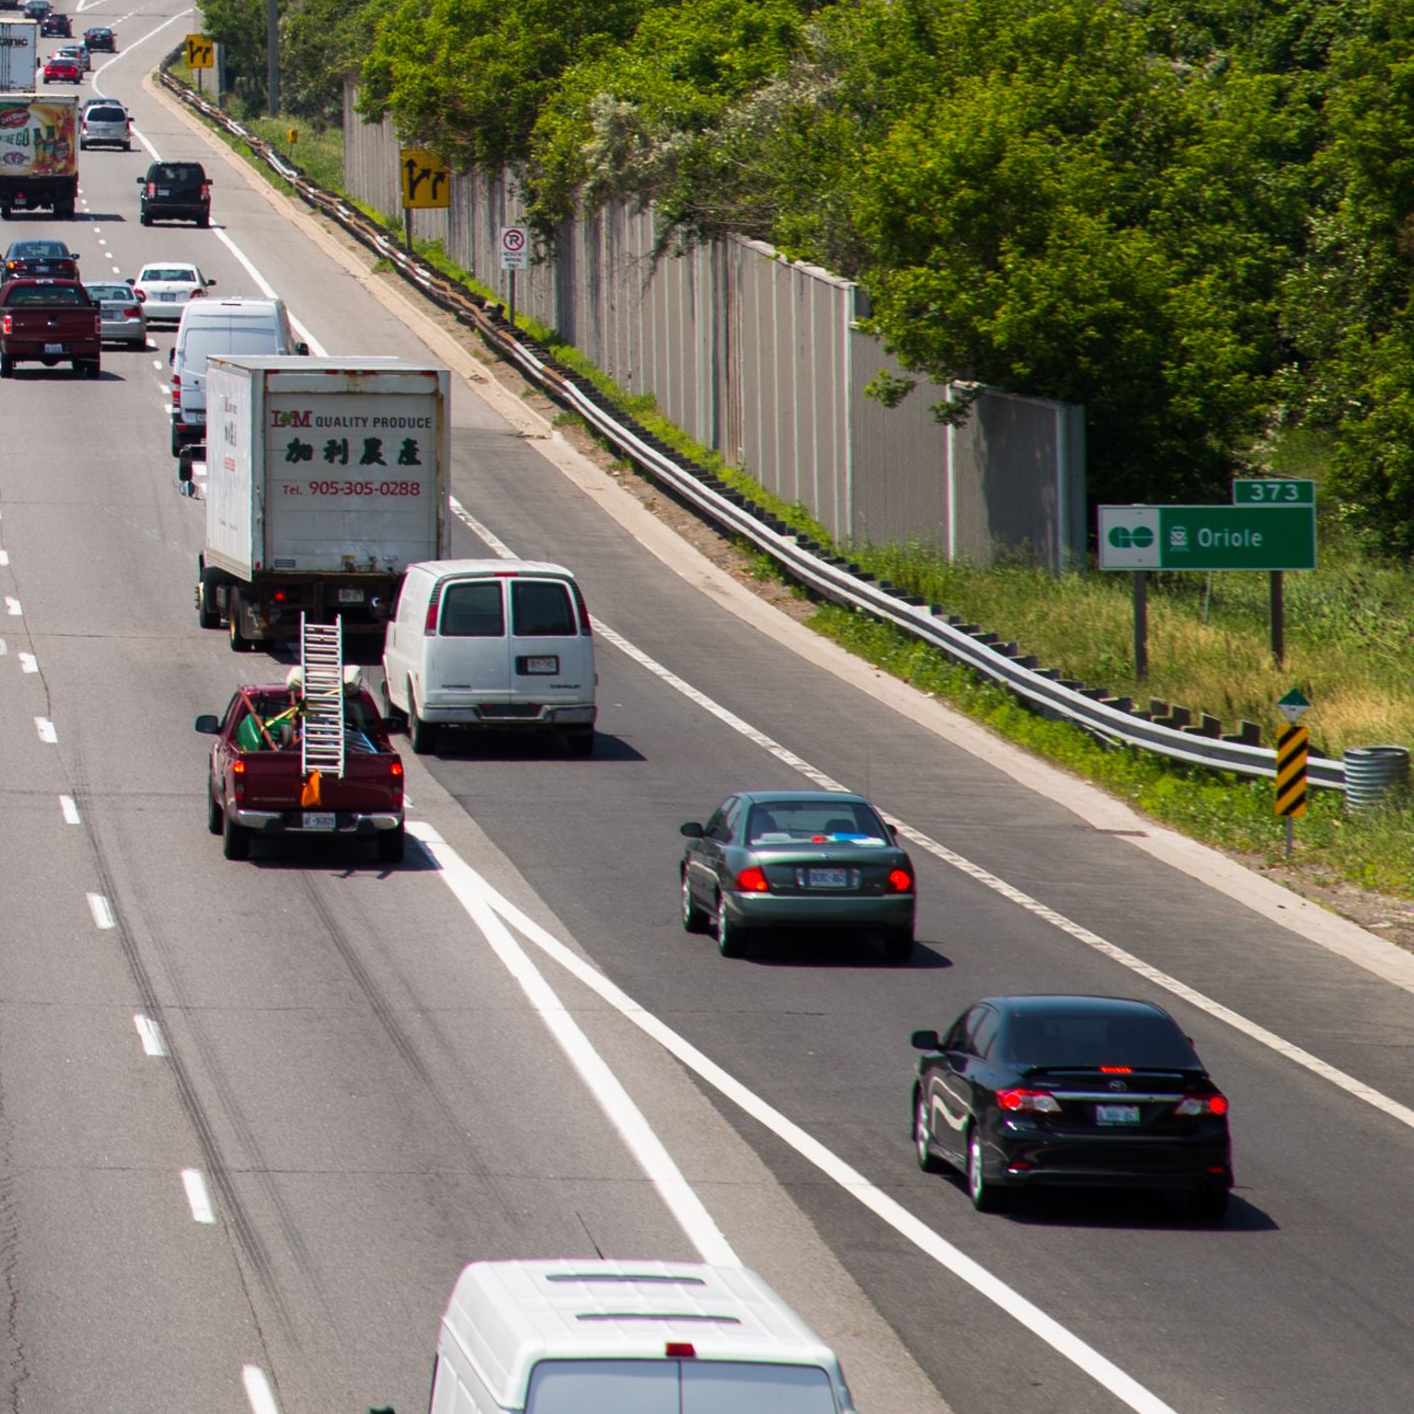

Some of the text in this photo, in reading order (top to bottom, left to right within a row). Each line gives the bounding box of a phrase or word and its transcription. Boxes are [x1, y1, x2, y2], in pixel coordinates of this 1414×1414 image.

[16, 128, 30, 147] GO
[316, 417, 368, 428] QUALITY
[373, 417, 431, 428] PRODUCE
[282, 481, 420, 496] Tel. 905-305-0288
[1251, 484, 1300, 502] 373
[1198, 528, 1263, 548] Oriole
